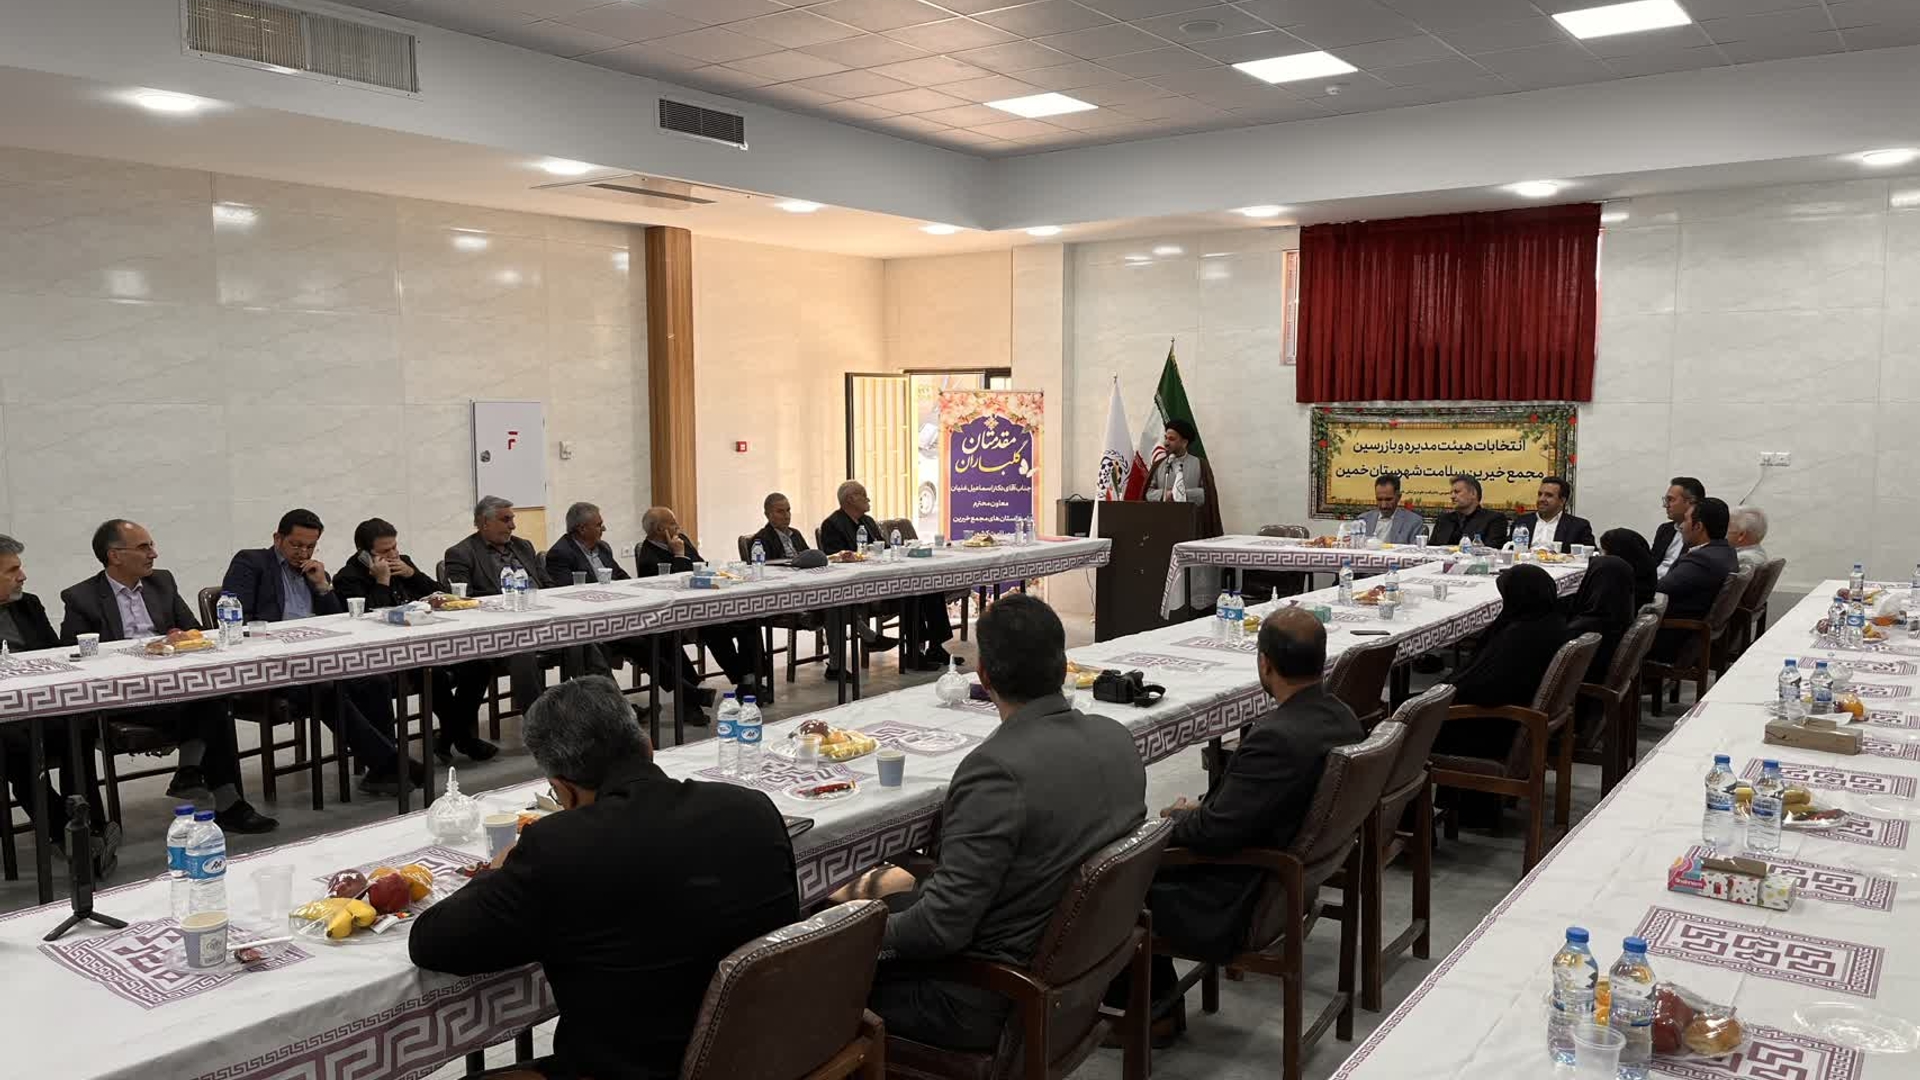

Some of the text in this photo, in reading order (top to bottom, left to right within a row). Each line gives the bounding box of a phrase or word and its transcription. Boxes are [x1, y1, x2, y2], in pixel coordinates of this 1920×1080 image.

[961, 430, 1017, 455] مقدمتان
[1353, 439, 1526, 455] انتخابات هیئت مدیره و بازرسین
[954, 440, 1029, 476] گلباران
[1335, 465, 1369, 478] خمین
[1369, 464, 1423, 480] شهرستان
[1423, 465, 1466, 477] سلامت
[1506, 470, 1545, 484] مجمع
